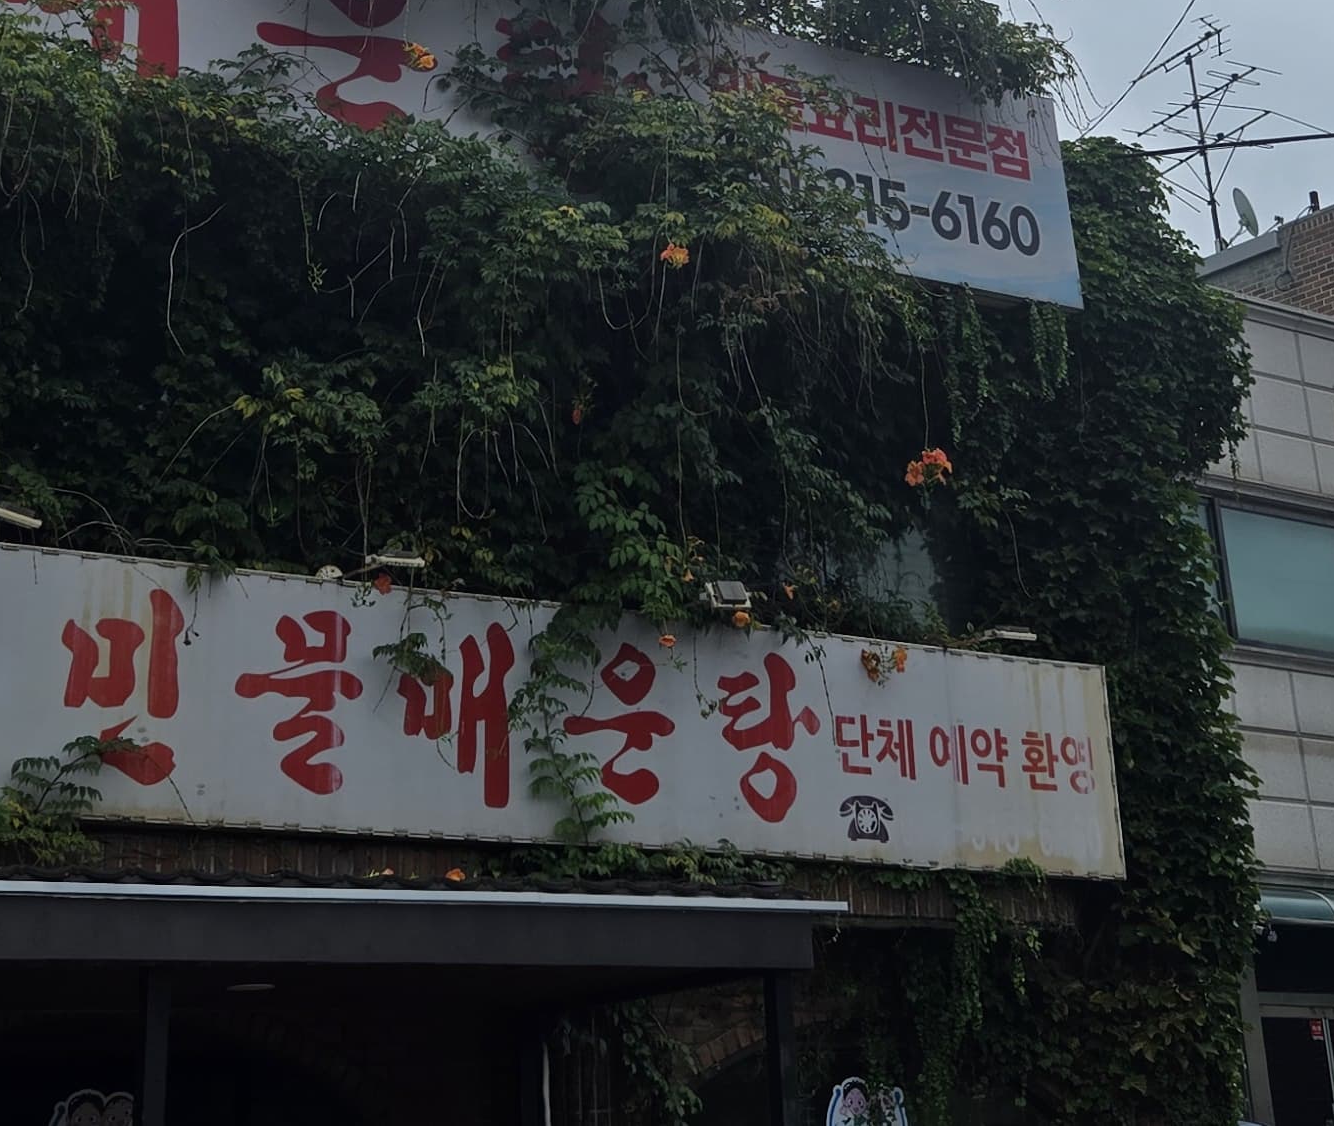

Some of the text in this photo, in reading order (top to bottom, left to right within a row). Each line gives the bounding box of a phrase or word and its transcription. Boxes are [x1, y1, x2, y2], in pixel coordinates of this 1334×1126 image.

[61, 588, 821, 823] 민물매운탕
[835, 714, 1096, 796] 단체 예약 환영
